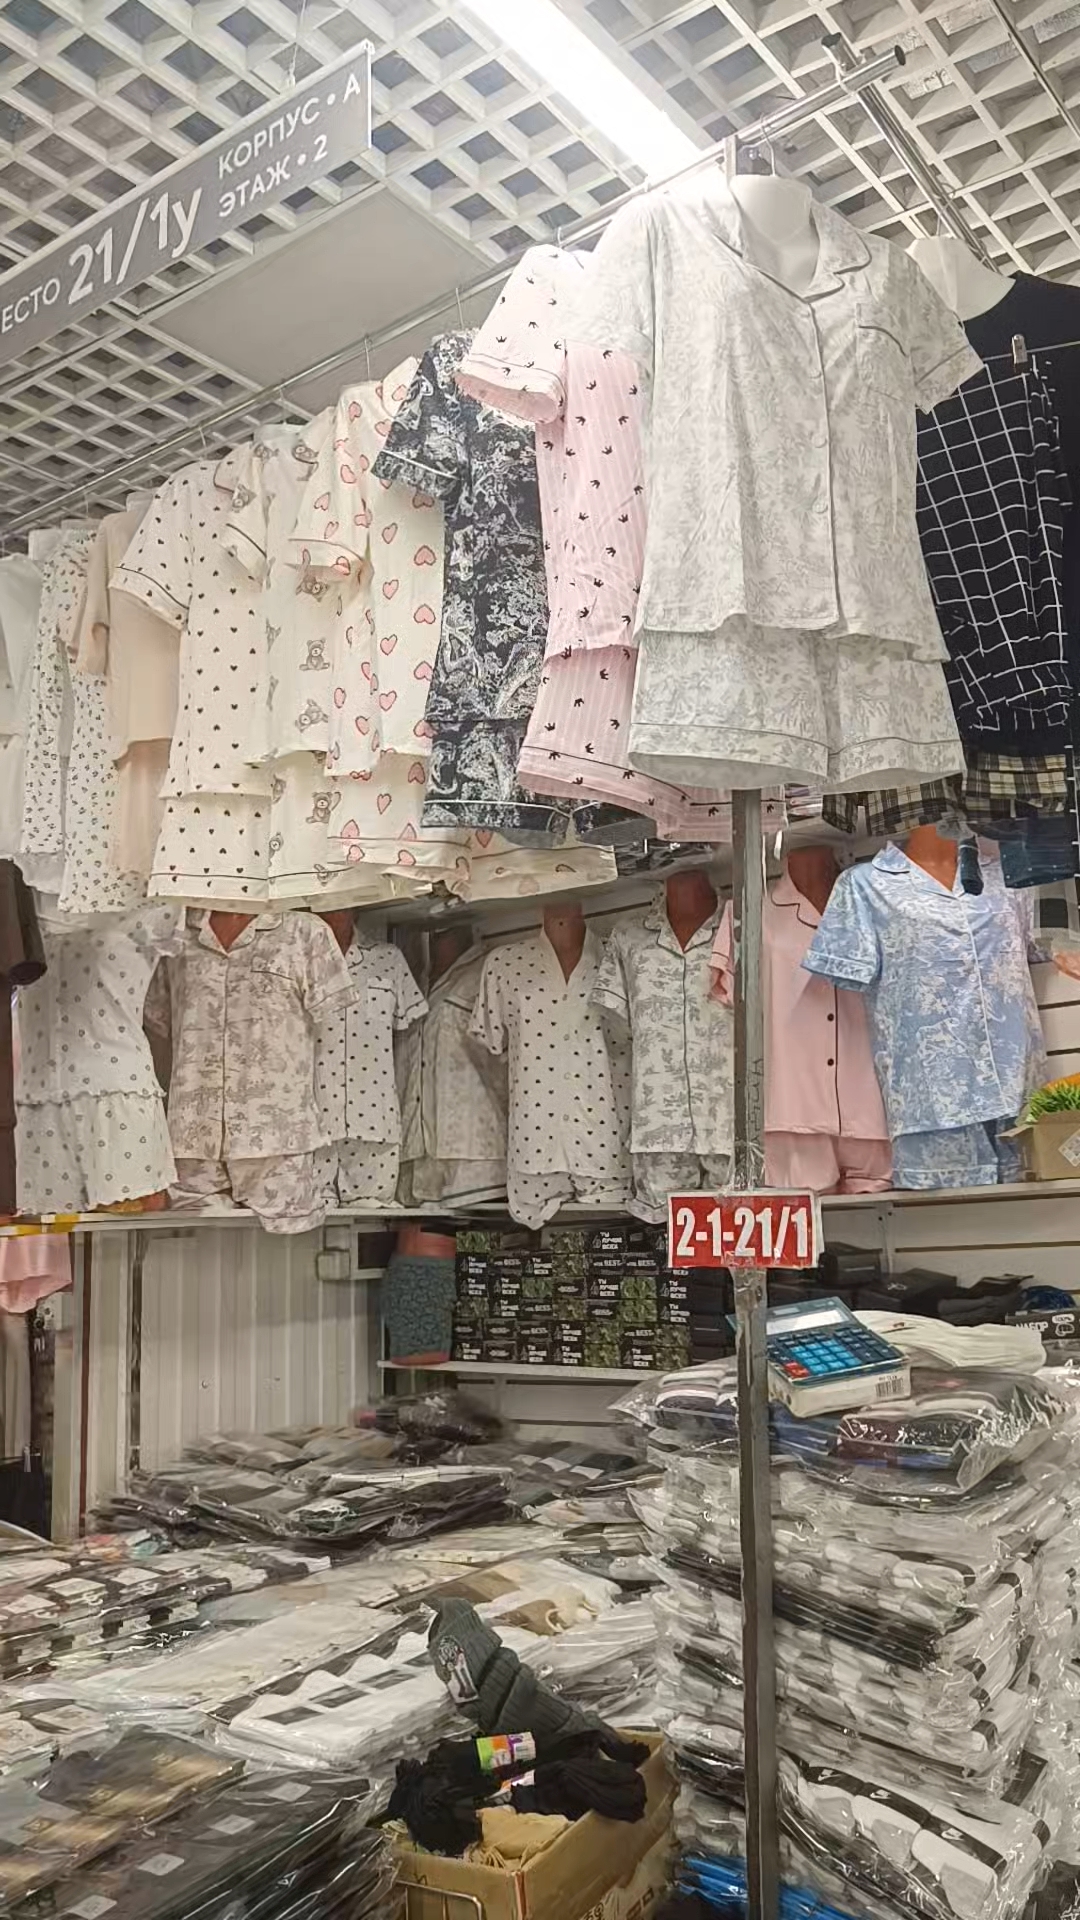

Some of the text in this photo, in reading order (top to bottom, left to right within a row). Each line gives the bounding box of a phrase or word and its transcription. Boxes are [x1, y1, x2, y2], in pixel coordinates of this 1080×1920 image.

[218, 73, 361, 180] КОРПУС А
[218, 134, 328, 218] ЭТАЖ 2
[676, 1206, 808, 1258] 2-1-21/1
